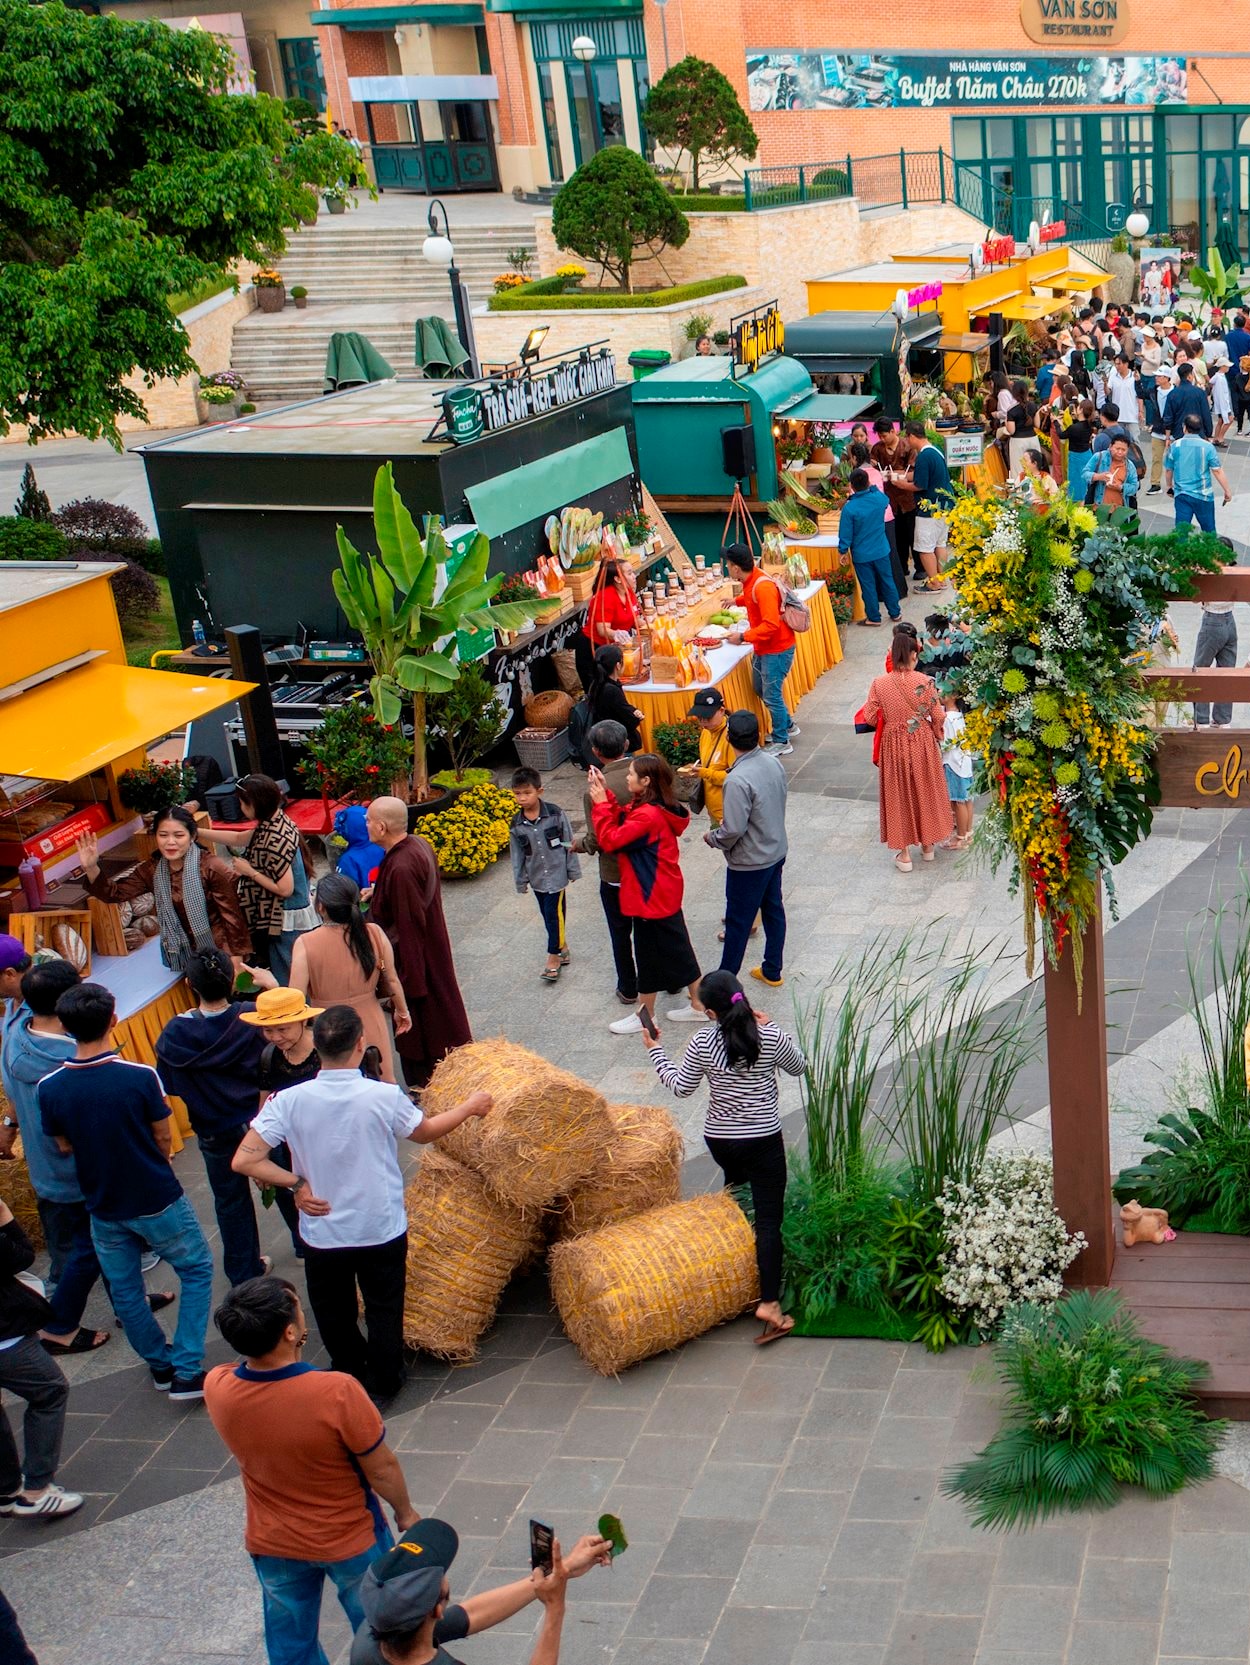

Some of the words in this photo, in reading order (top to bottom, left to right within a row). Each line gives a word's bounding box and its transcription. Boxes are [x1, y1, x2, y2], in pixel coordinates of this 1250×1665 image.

[1043, 23, 1114, 36] RESTAURANT
[949, 60, 967, 73] NHÀ
[969, 60, 991, 73] HÀNG
[898, 76, 952, 106] Buffet
[956, 77, 998, 100] Năm
[1002, 76, 1045, 100] Châu
[1048, 75, 1088, 100] 270k
